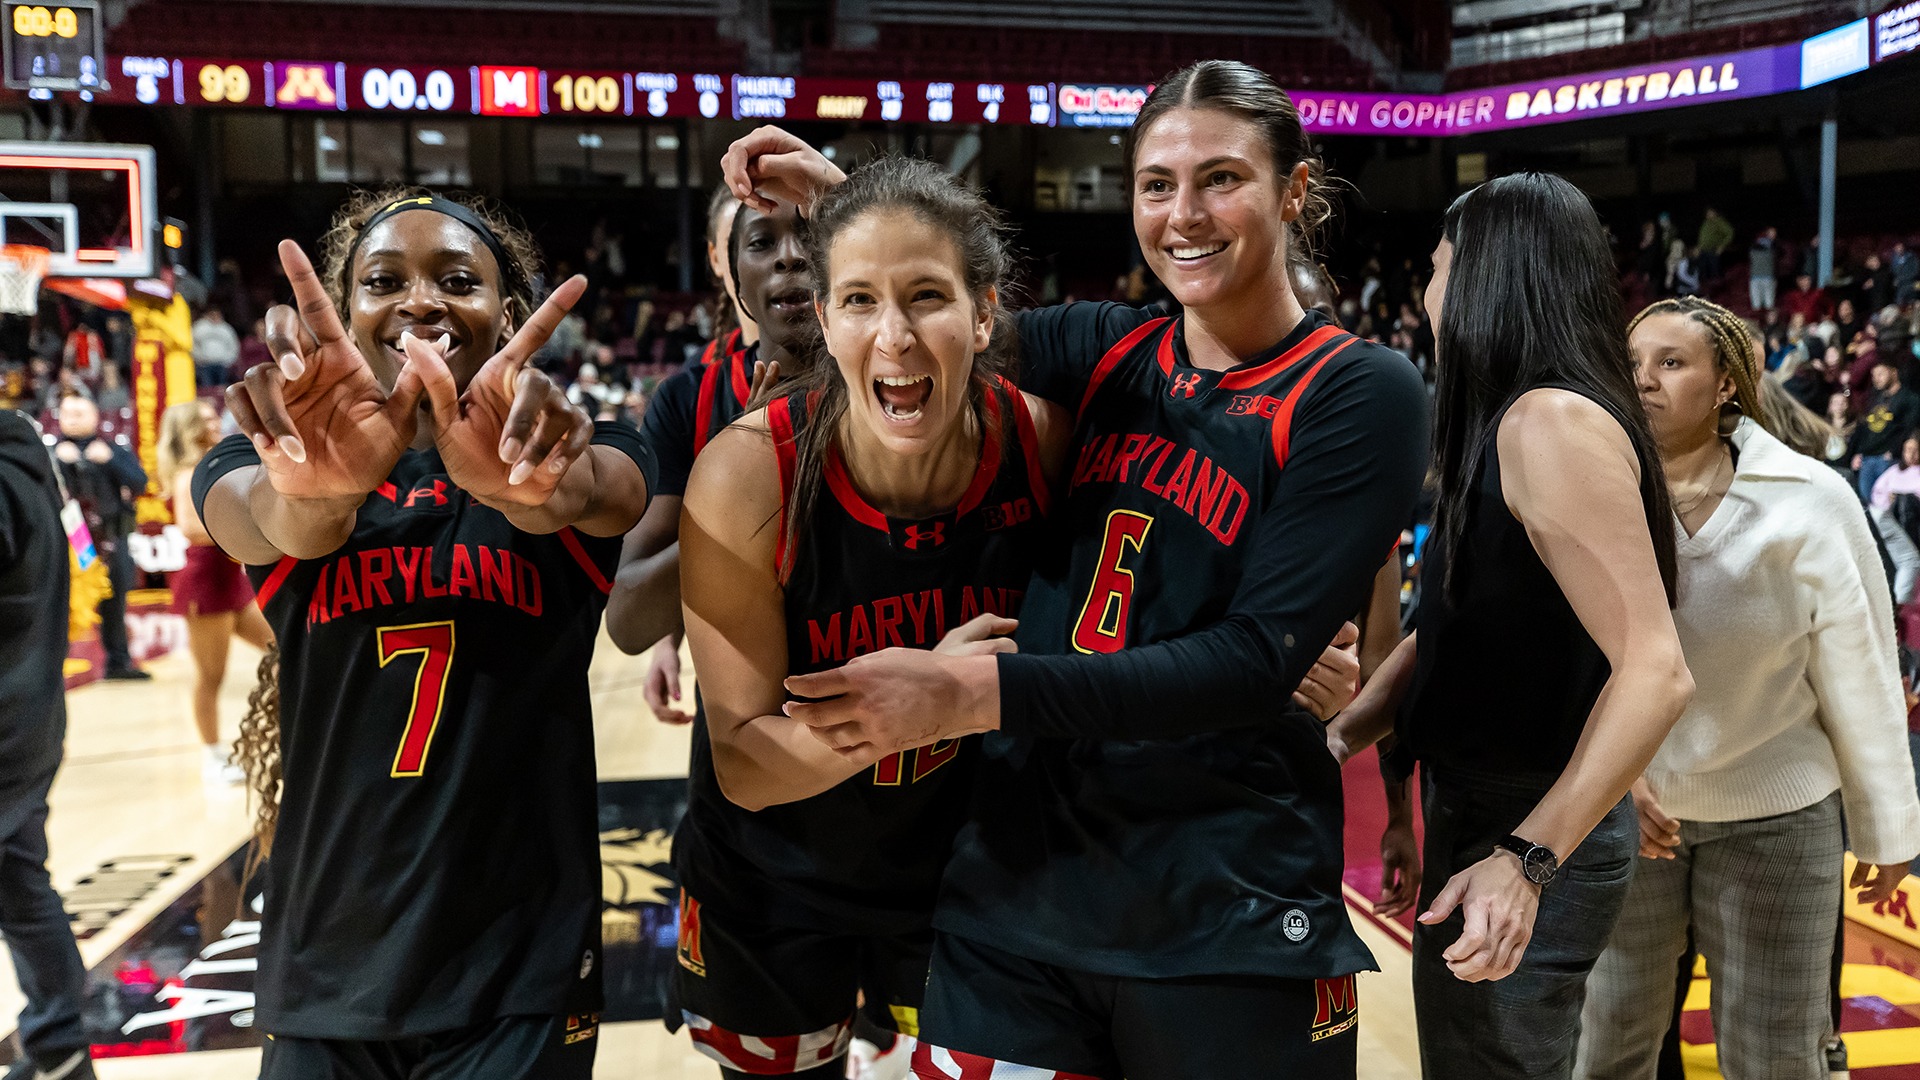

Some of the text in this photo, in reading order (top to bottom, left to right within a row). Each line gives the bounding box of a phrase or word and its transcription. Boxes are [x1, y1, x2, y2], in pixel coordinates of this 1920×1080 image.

[198, 64, 250, 103] 99
[276, 64, 336, 104] M
[362, 68, 454, 110] 00.0
[493, 70, 527, 108] M
[553, 74, 620, 112] 100
[736, 76, 796, 98] HUSTLE
[1370, 96, 1495, 129] GOPHER
[1505, 62, 1739, 120] BASKETBALL
[698, 90, 720, 118] 0
[1072, 509, 1154, 655] 6
[376, 620, 456, 778] 7
[1290, 918, 1302, 927] LG
